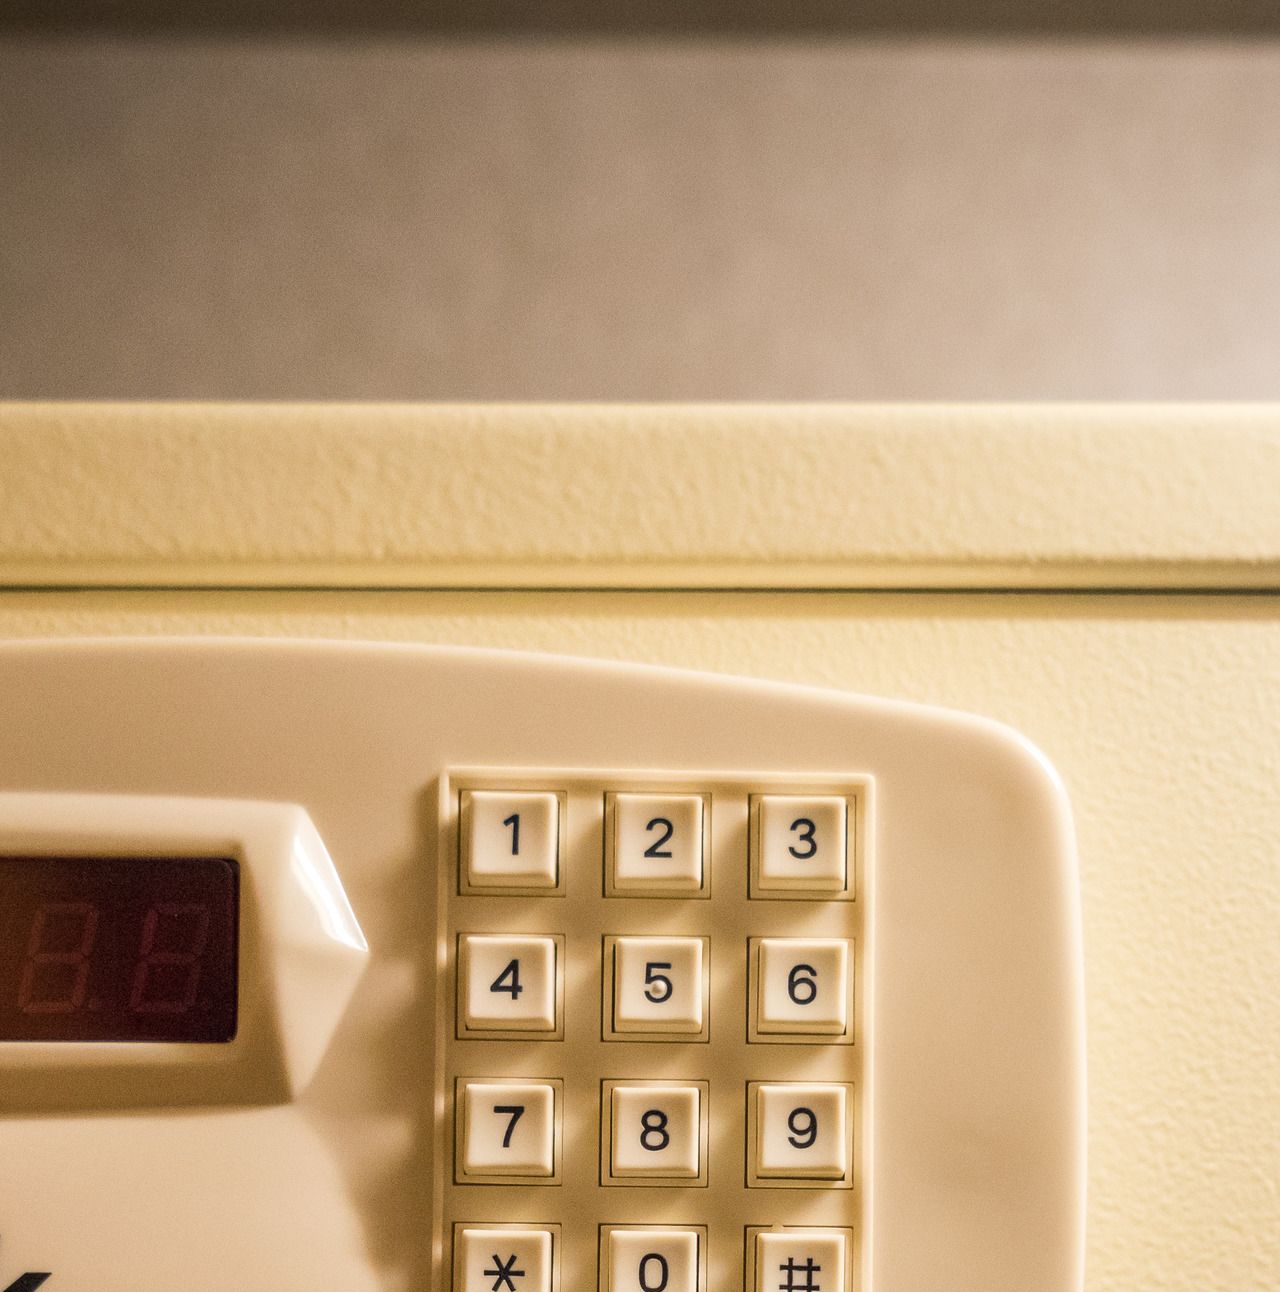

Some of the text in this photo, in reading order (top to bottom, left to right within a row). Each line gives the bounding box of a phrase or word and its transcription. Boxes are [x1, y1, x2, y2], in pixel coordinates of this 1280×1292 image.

[504, 814, 520, 855] 1
[644, 818, 673, 858] 2
[789, 818, 817, 859] 3
[490, 959, 522, 1000] 4
[645, 962, 673, 1003] 5
[788, 964, 817, 1005] 6
[494, 1106, 525, 1147] 7
[641, 1110, 669, 1151] 8
[788, 1107, 817, 1149] 9
